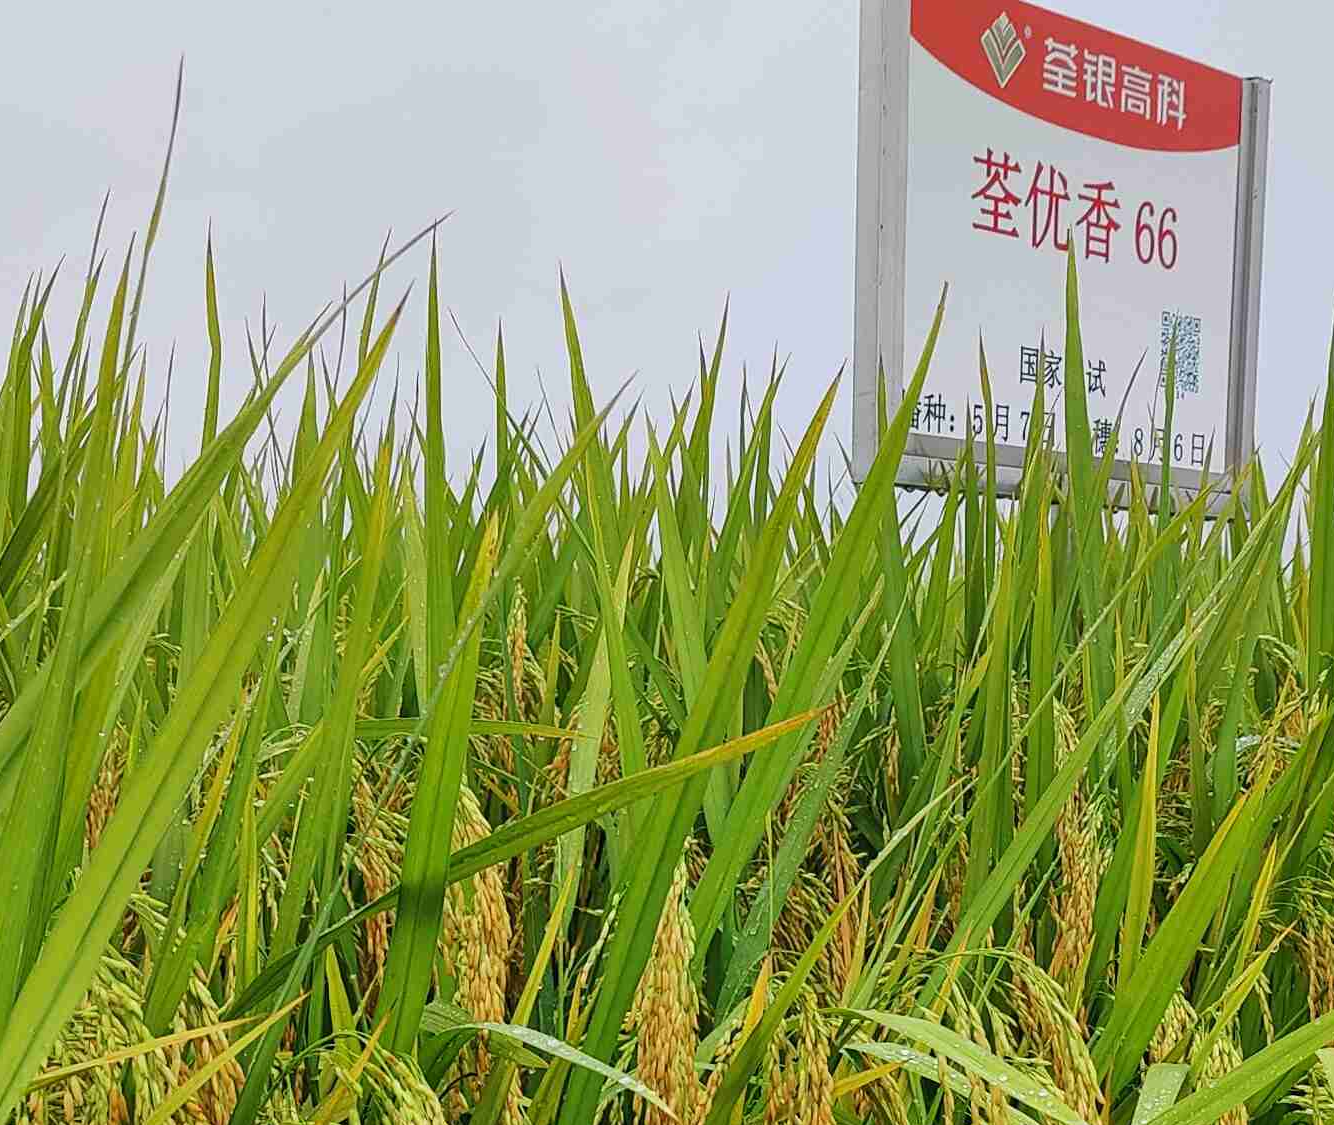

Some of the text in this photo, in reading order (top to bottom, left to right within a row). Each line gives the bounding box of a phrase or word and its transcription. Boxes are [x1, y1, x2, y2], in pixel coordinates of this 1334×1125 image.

[1042, 37, 1187, 131] 荃银高科
[1020, 346, 1107, 398] 国家试
